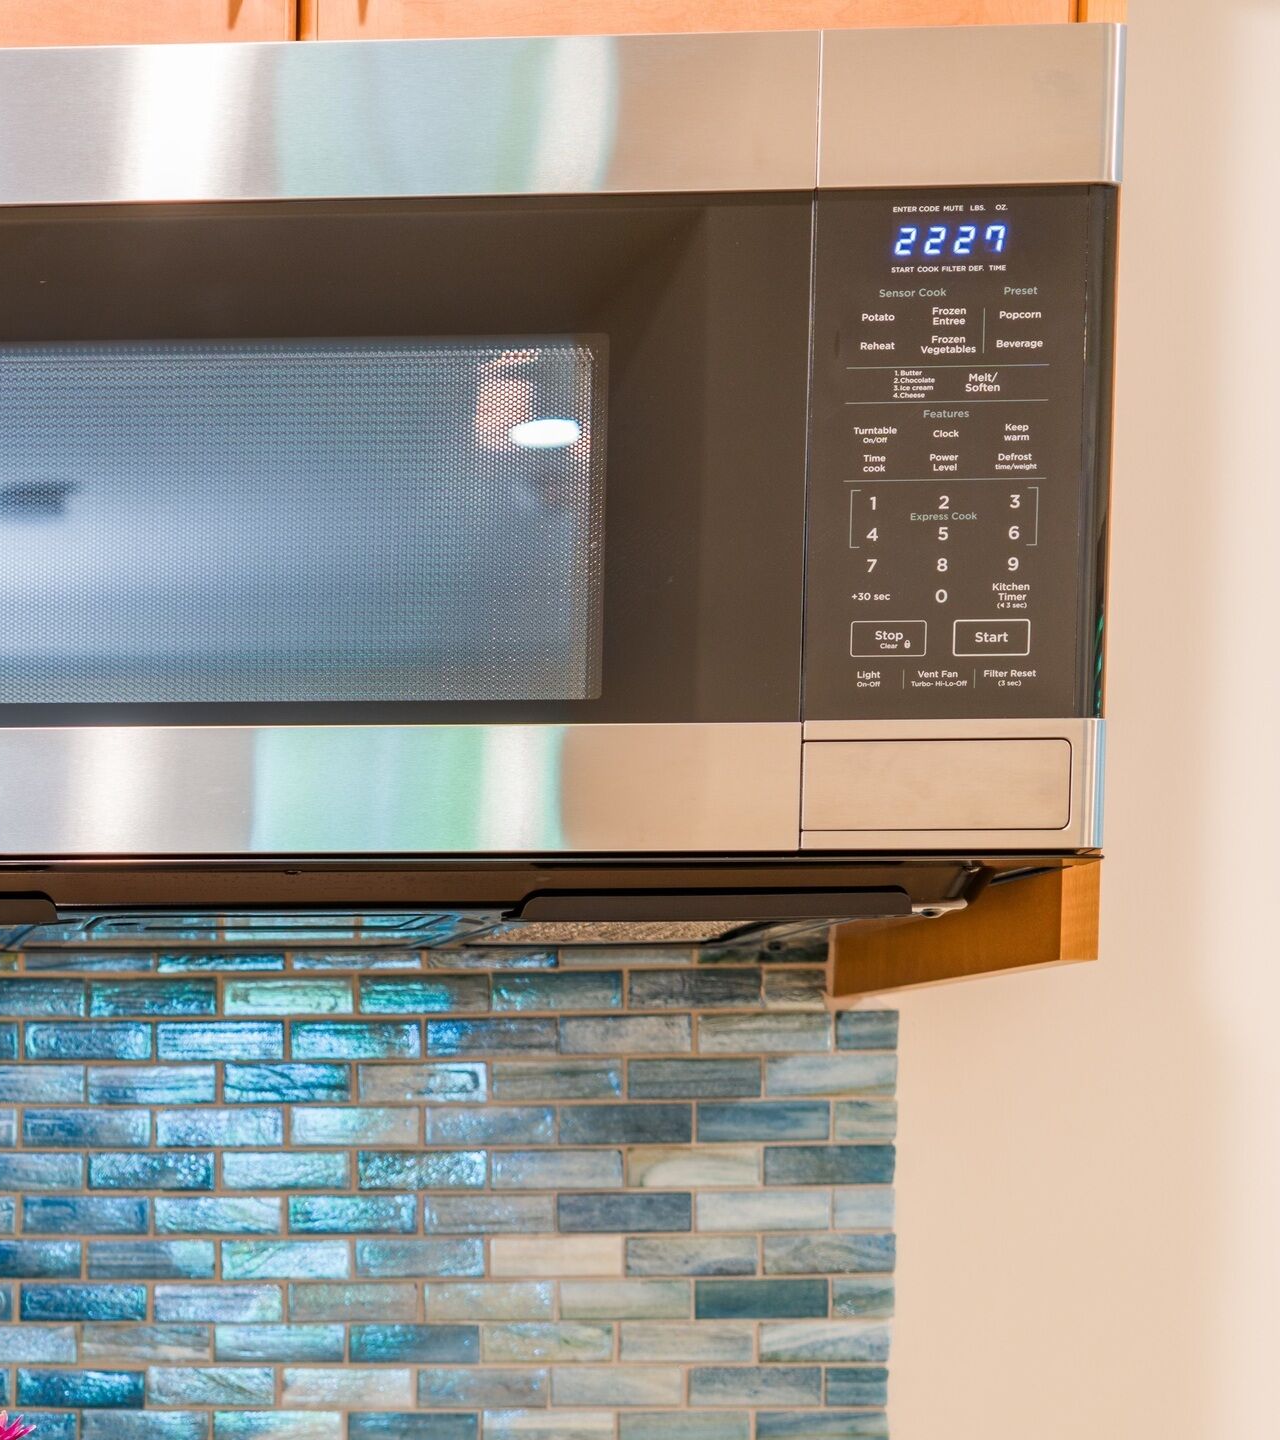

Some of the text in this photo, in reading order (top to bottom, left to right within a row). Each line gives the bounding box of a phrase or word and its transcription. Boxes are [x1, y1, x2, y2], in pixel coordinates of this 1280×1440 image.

[880, 288, 946, 297] Sensor Cook
[1004, 287, 1037, 295] Preset
[932, 307, 966, 315] Frozen
[1000, 311, 1041, 320] Popcorn
[862, 313, 895, 321] Potato
[933, 317, 965, 325] Entree
[860, 342, 895, 350] Reheat
[996, 340, 1043, 349] Beverage
[921, 345, 976, 355] Vegetables
[969, 372, 998, 382] Melt/
[966, 383, 1000, 392] Soften
[923, 410, 969, 418] Features
[1005, 424, 1029, 432] Keep
[998, 453, 1032, 461] Defrost
[863, 464, 885, 472] cook
[870, 497, 876, 510] 1
[939, 496, 949, 509] 2
[1010, 495, 1020, 508] 3
[910, 512, 977, 522] Express Cook
[867, 528, 878, 541] 4
[938, 527, 948, 540] 5
[1009, 526, 1019, 539] 6
[867, 559, 877, 572] 7
[937, 558, 947, 572] 8
[1008, 557, 1018, 571] 9
[992, 583, 1030, 591] Kitchen
[936, 589, 947, 603] 0
[875, 631, 903, 641] Stop
[975, 632, 1008, 642] Start
[857, 671, 880, 680] Light
